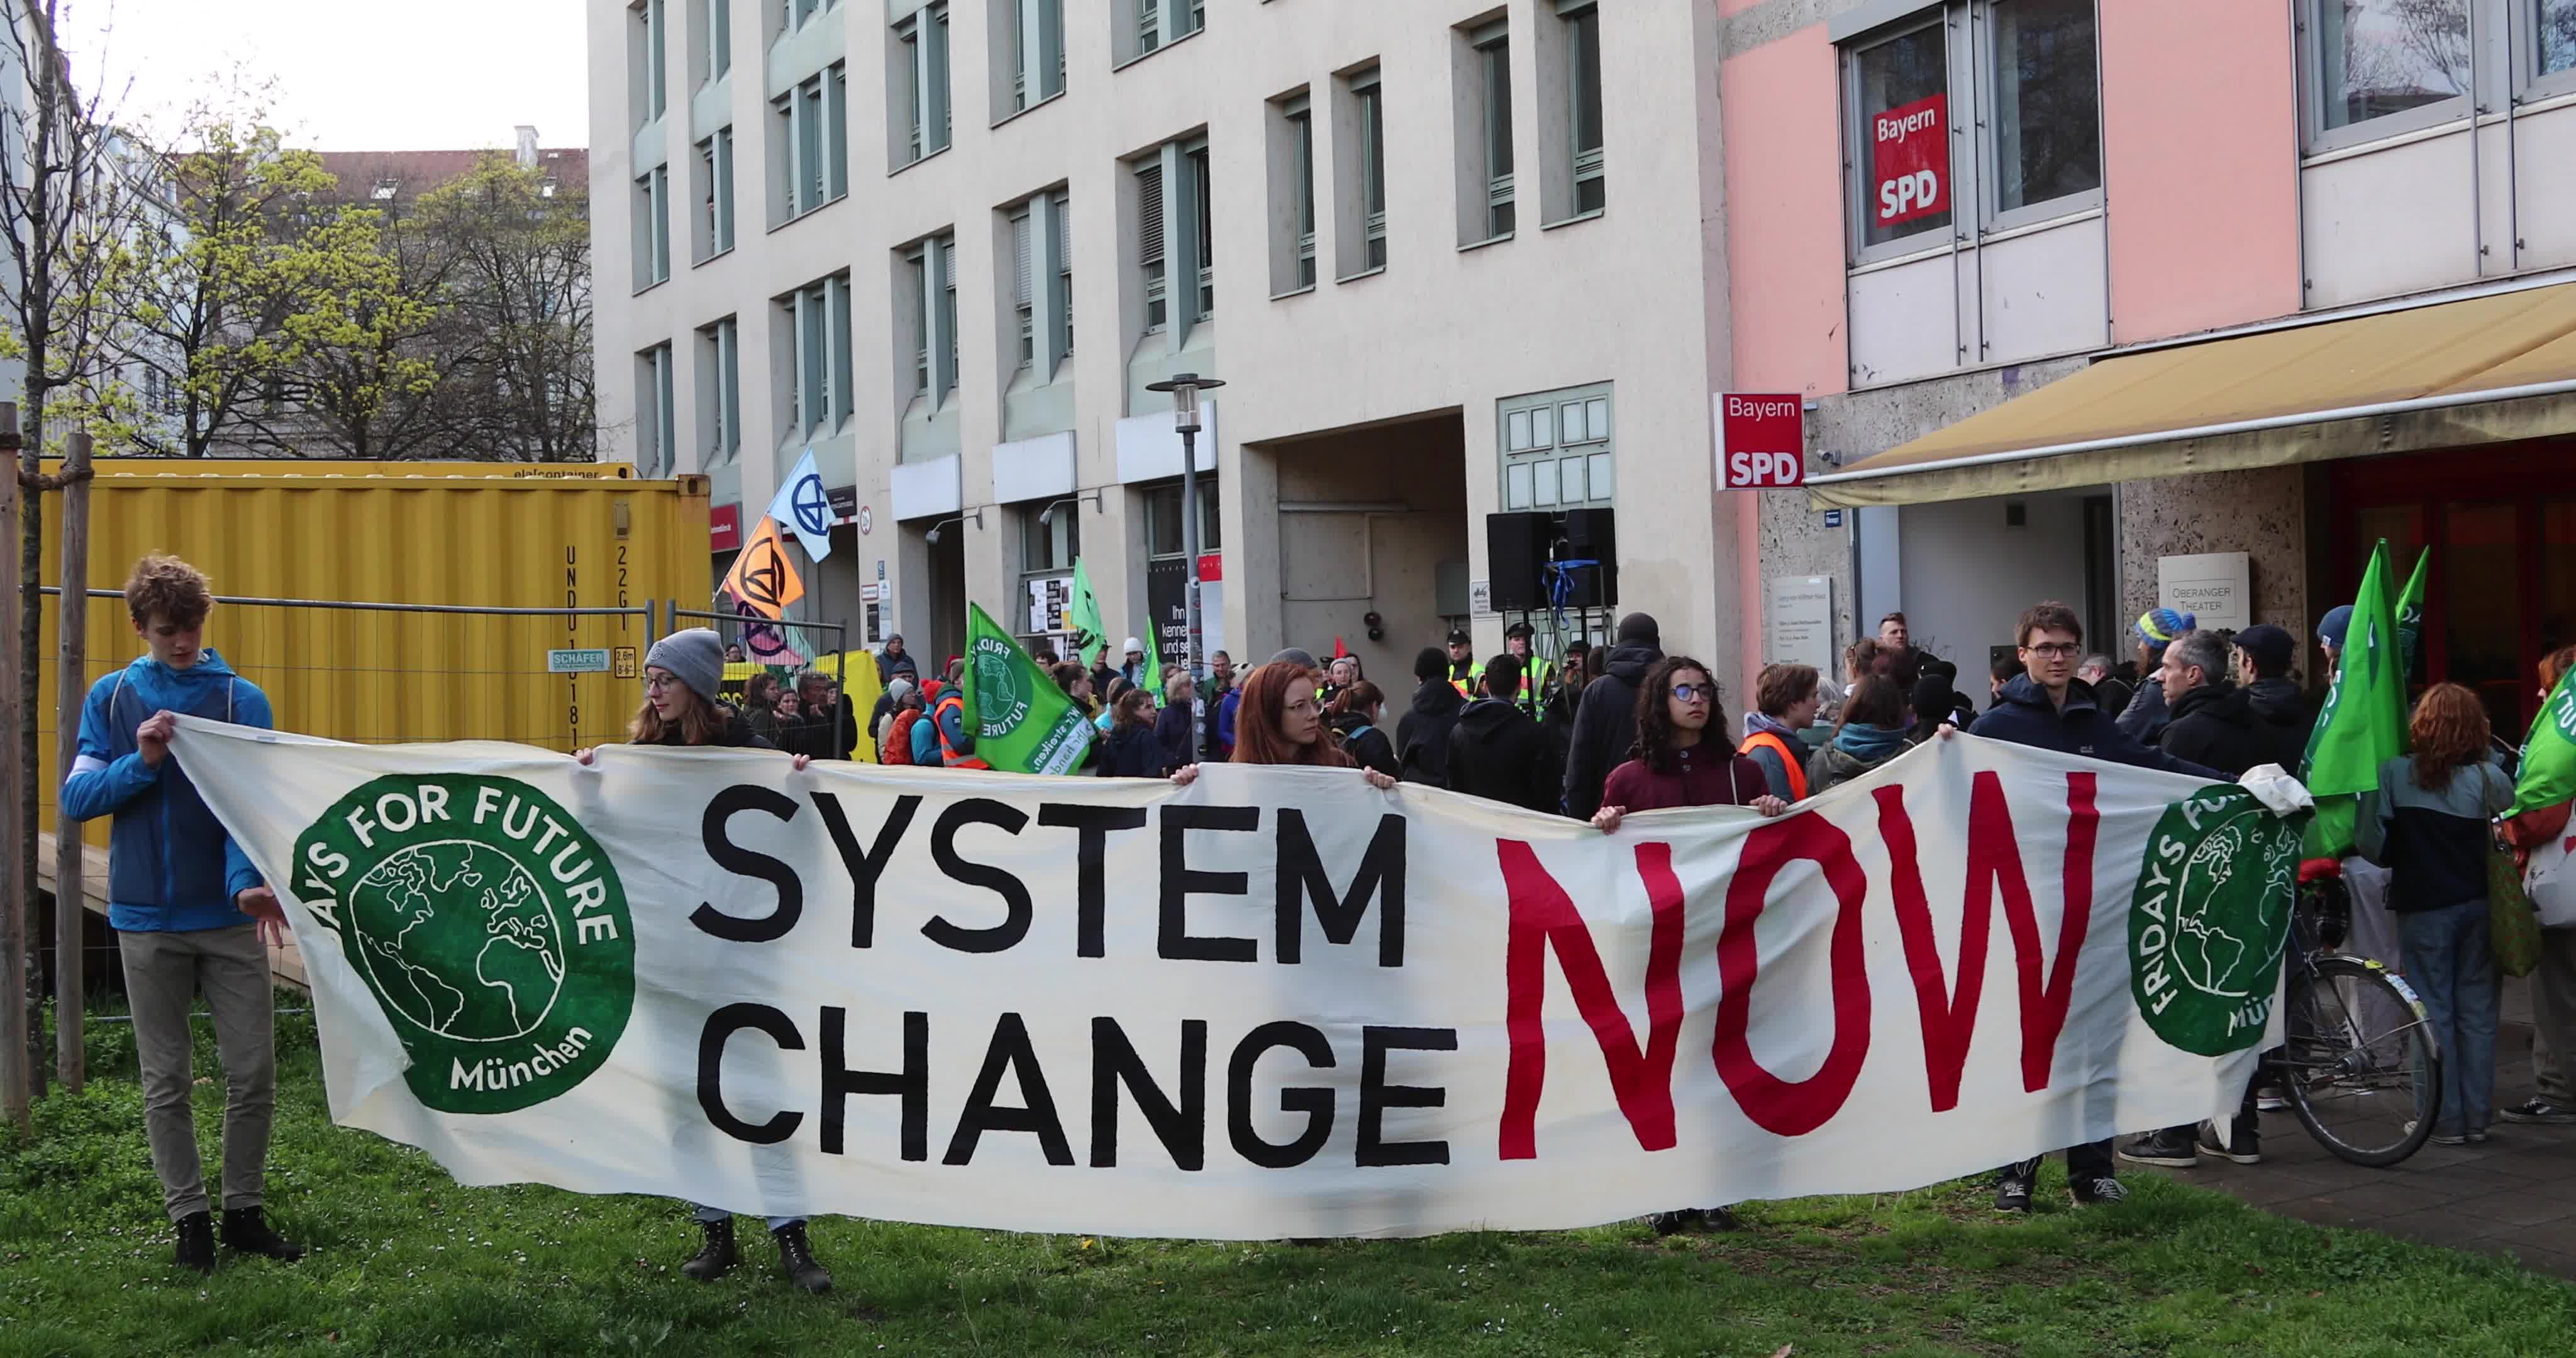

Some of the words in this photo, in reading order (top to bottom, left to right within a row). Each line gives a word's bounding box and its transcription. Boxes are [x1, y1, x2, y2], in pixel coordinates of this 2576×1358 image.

[1877, 108, 1935, 144] Bayern
[1880, 169, 1937, 219] SPD
[1729, 397, 1795, 422] Bayern
[1731, 451, 1798, 486] SPD
[1172, 605, 1185, 620] Ihn
[2172, 587, 2231, 598] OBERANGER
[2179, 601, 2223, 611] THEATER
[1163, 639, 1179, 654] und
[346, 785, 451, 849] FOR
[473, 785, 618, 945] FUTURE
[688, 783, 1407, 968] SYSTEM
[2140, 834, 2187, 1017] FRIDAYS
[1496, 770, 2100, 1160] NOW
[450, 1025, 593, 1091] München
[697, 1002, 1458, 1171] CHANGE
